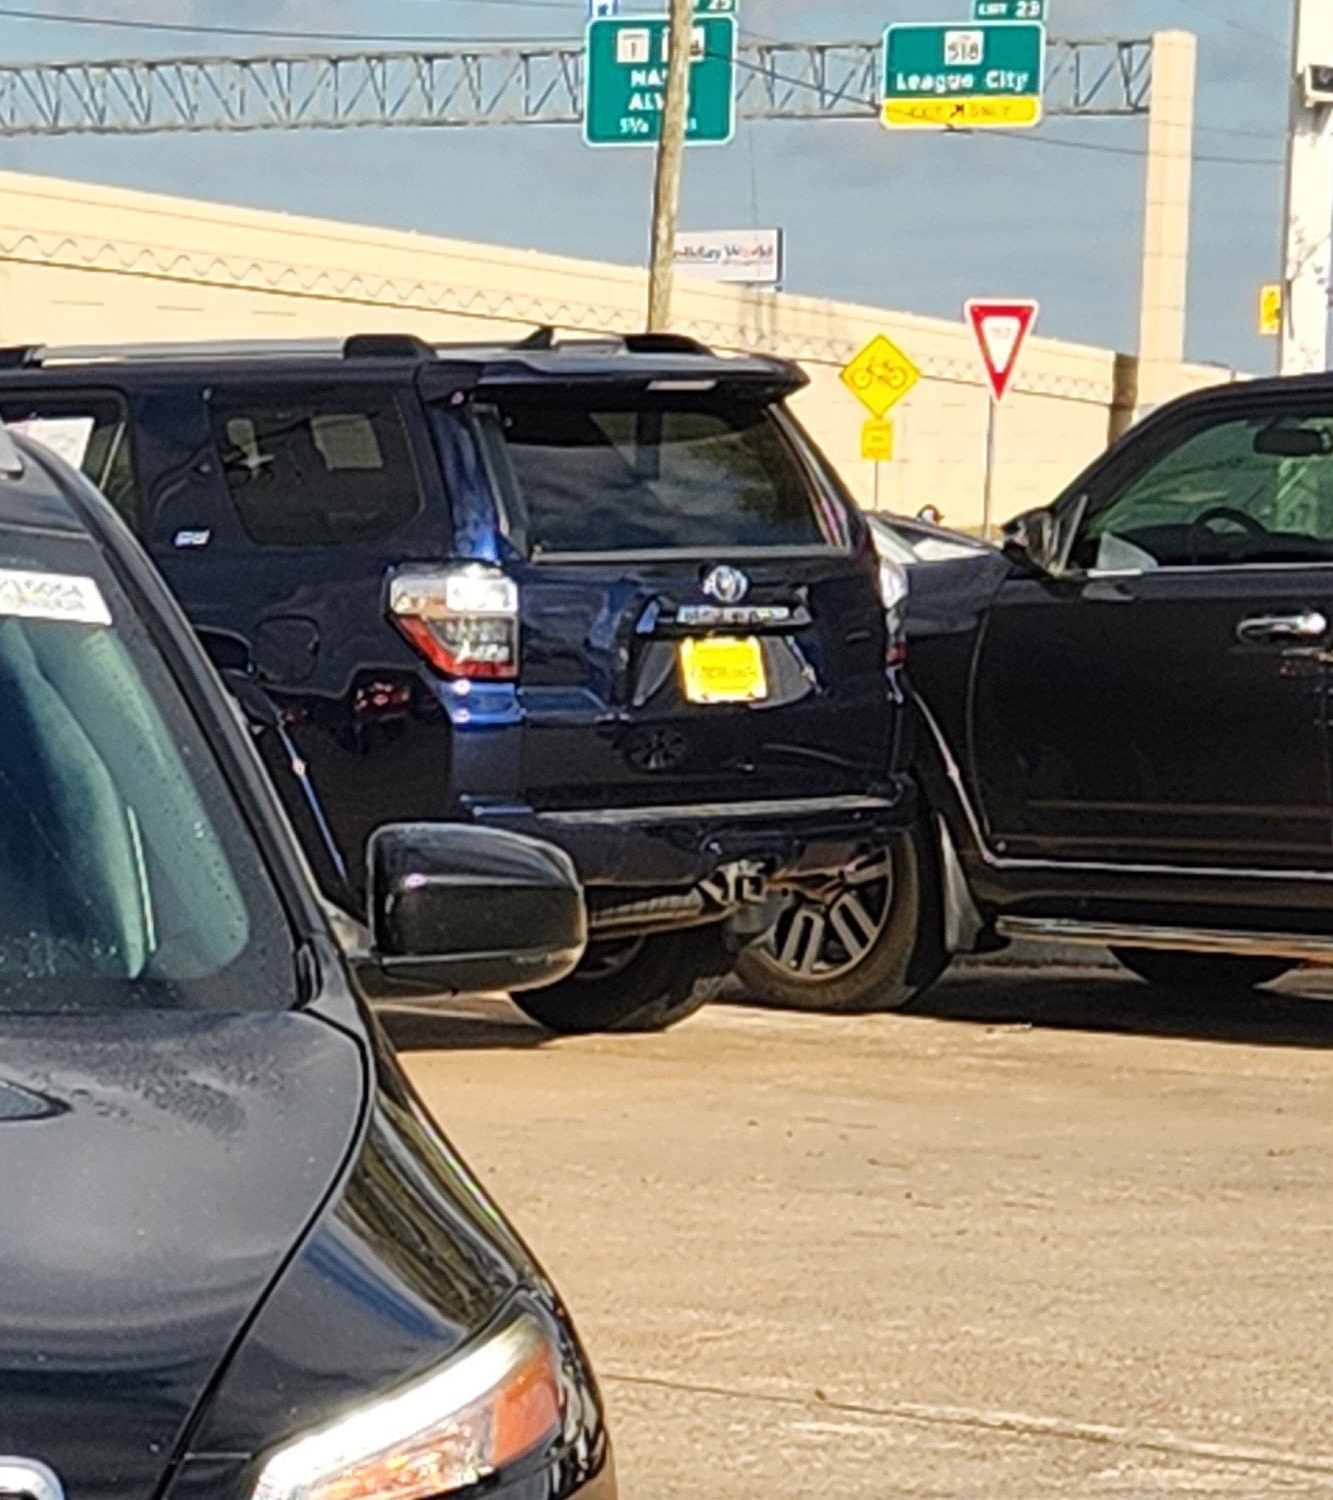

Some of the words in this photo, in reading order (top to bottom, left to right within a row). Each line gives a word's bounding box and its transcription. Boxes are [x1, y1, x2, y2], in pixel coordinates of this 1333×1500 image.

[947, 42, 980, 60] 518
[896, 72, 975, 93] League
[986, 69, 1030, 91] City
